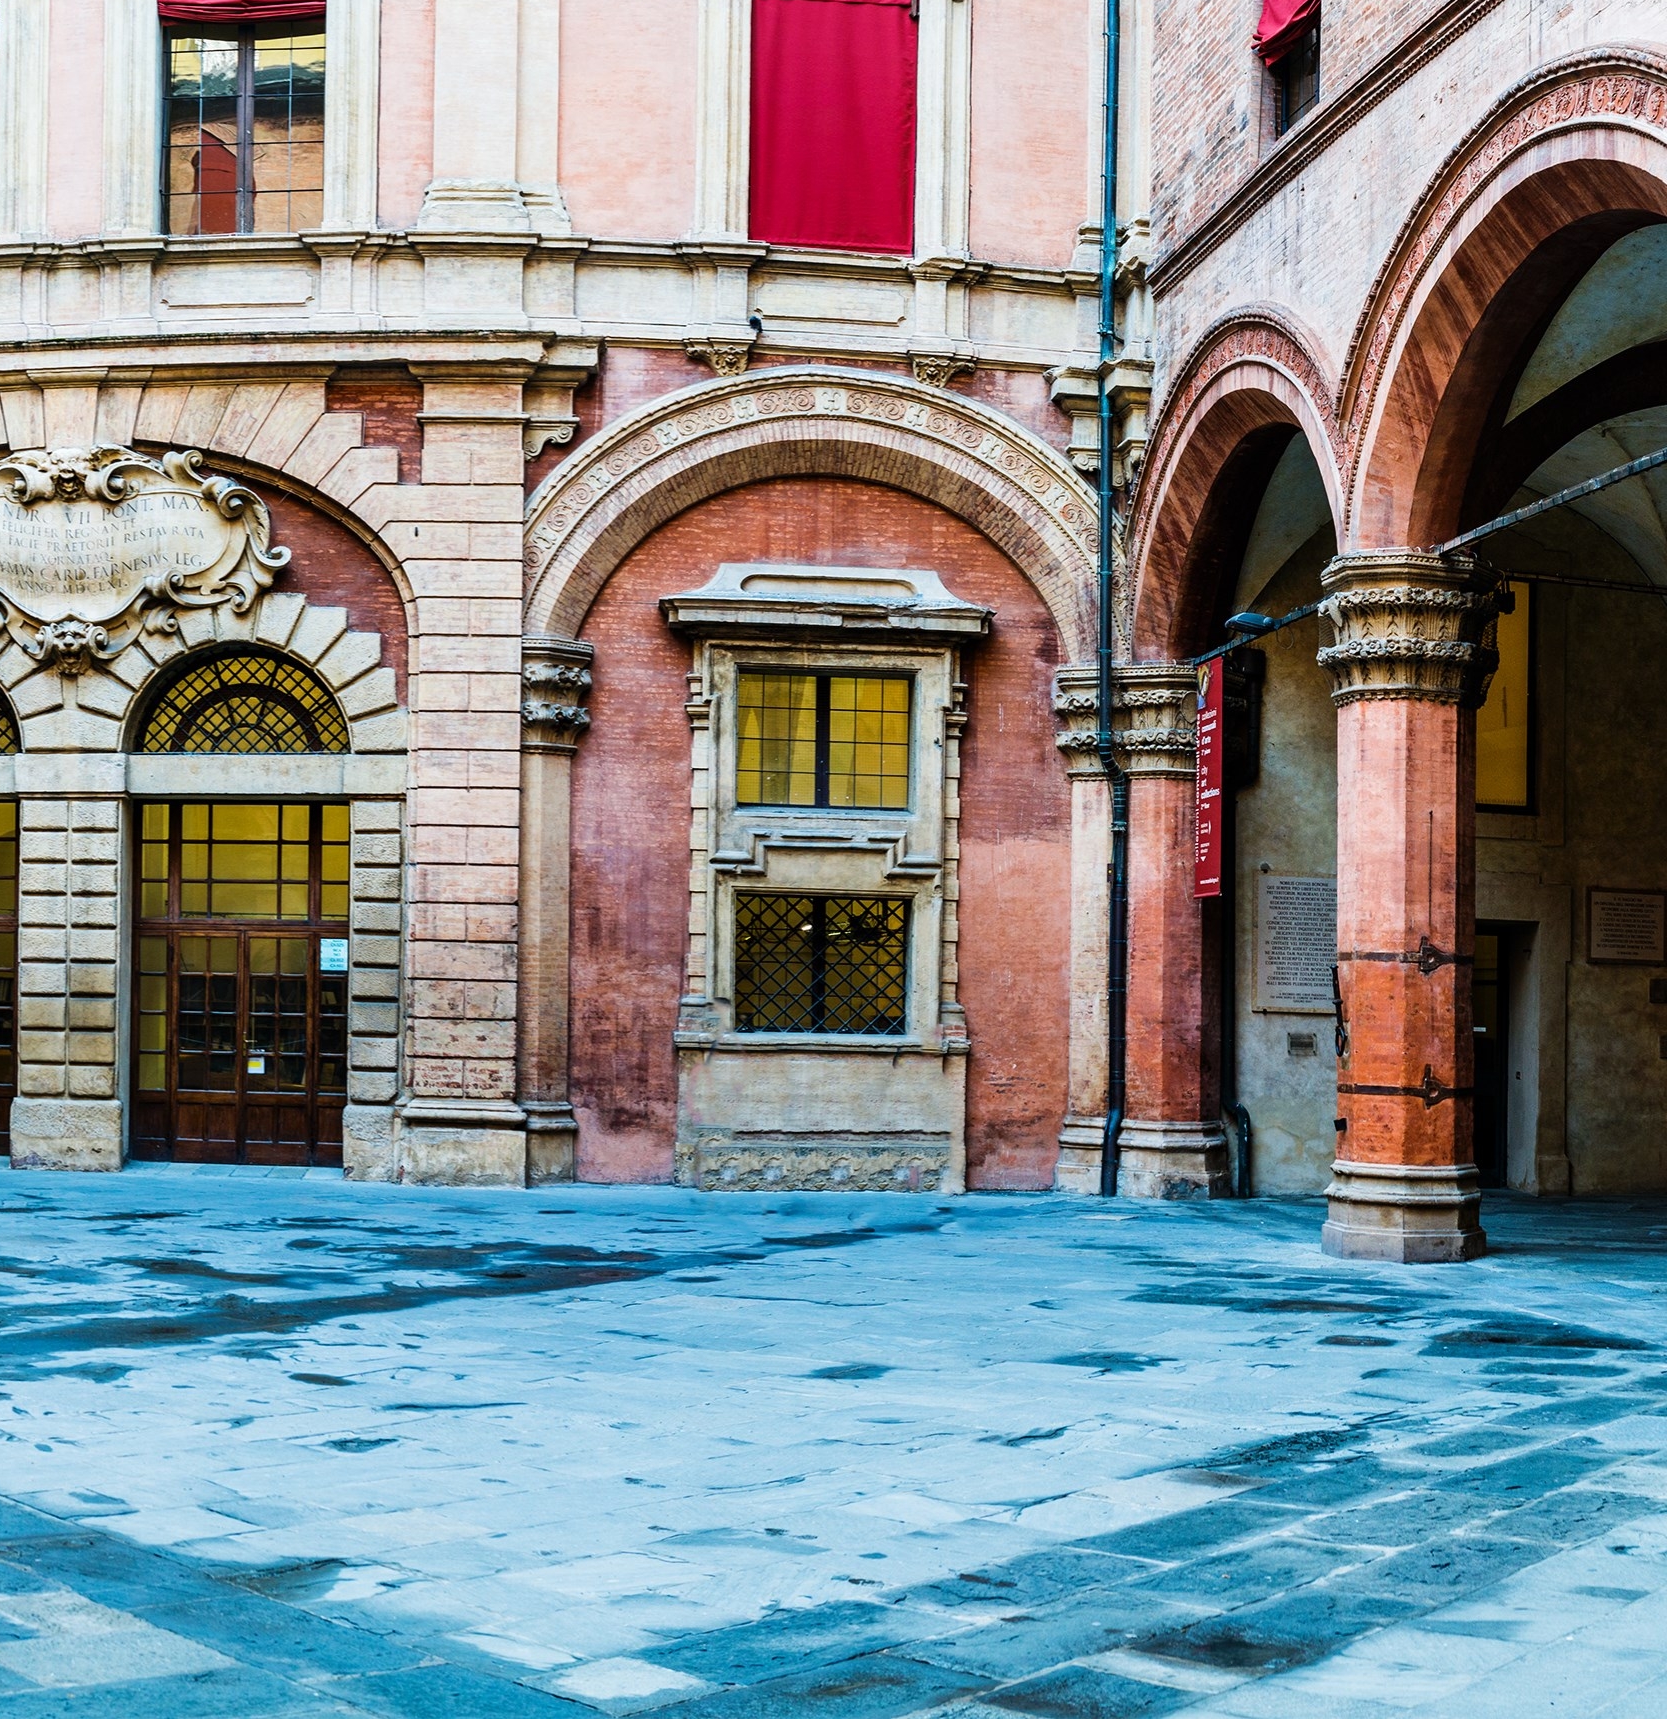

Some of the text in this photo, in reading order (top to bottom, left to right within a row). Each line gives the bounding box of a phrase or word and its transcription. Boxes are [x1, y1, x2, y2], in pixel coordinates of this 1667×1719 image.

[65, 511, 90, 527] VII
[162, 495, 209, 513] MAX.
[65, 518, 136, 539] REGNANTE
